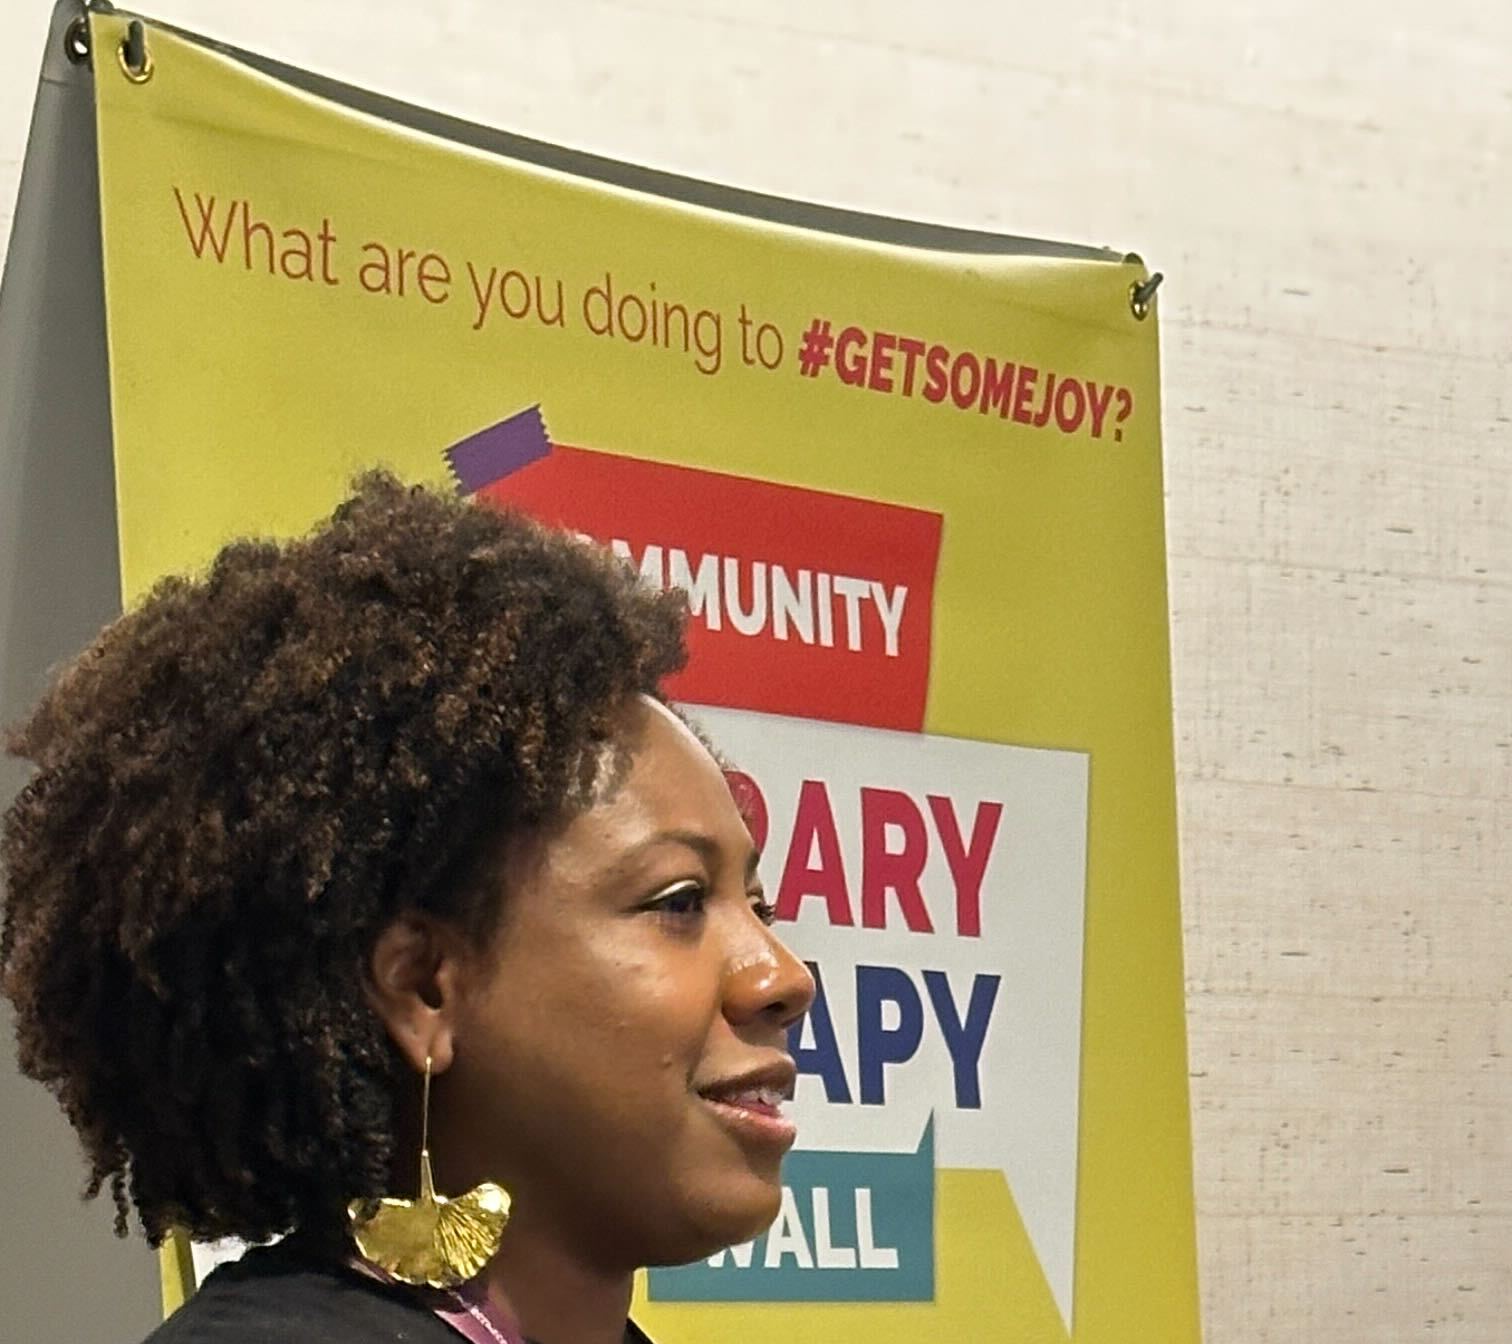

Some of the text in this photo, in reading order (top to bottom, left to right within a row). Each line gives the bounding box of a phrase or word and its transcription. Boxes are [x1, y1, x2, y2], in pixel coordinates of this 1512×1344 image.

[174, 186, 1133, 443] What are you doing to #GETSOMEJOY?
[706, 1186, 899, 1269] ALL
